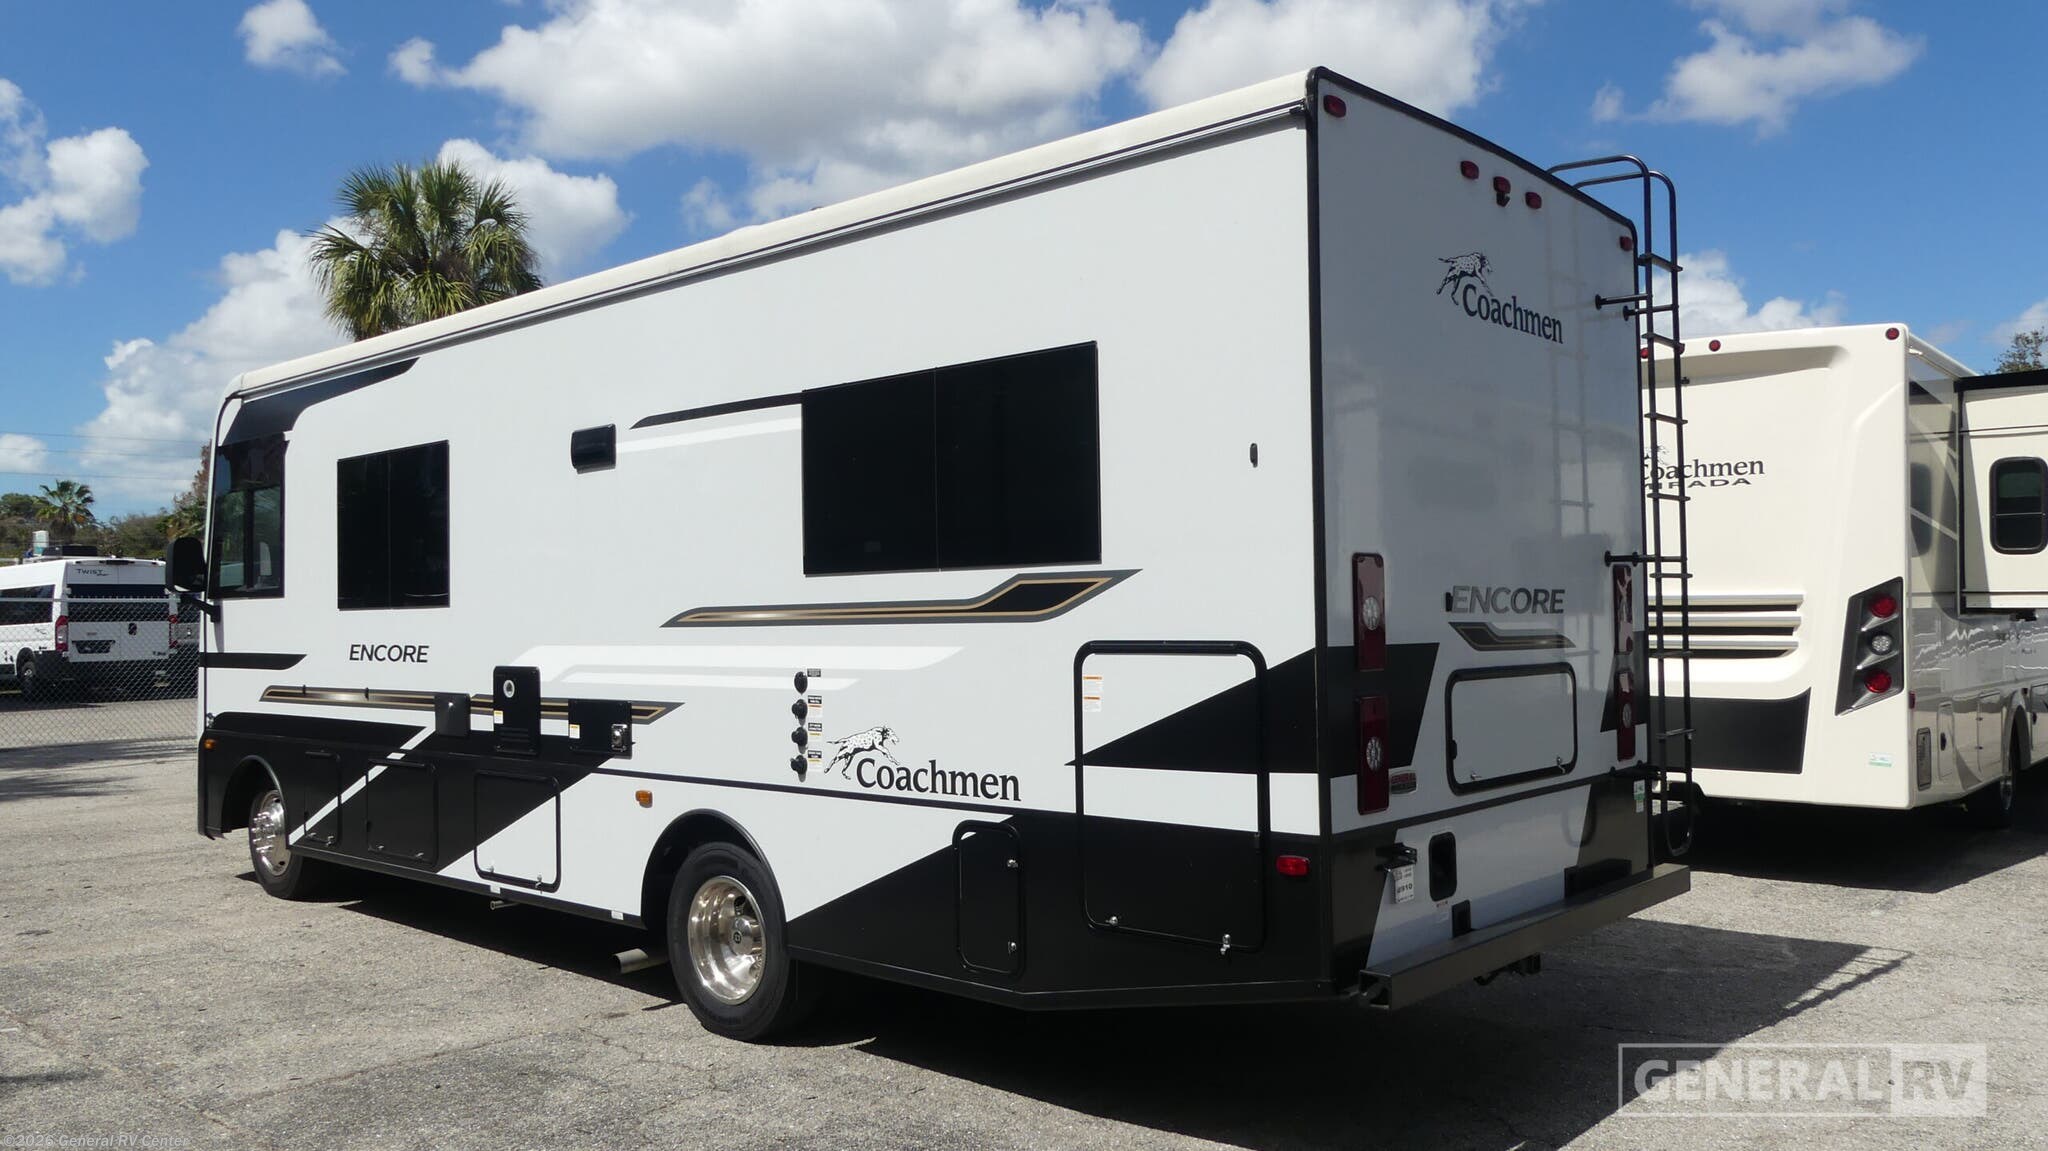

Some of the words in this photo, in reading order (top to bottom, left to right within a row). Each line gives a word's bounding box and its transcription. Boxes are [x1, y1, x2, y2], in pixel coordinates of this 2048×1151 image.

[1462, 283, 1564, 345] Coachmen
[1452, 585, 1566, 614] ENCORE
[349, 644, 430, 663] ENCORE
[856, 757, 1022, 802] Coachmen
